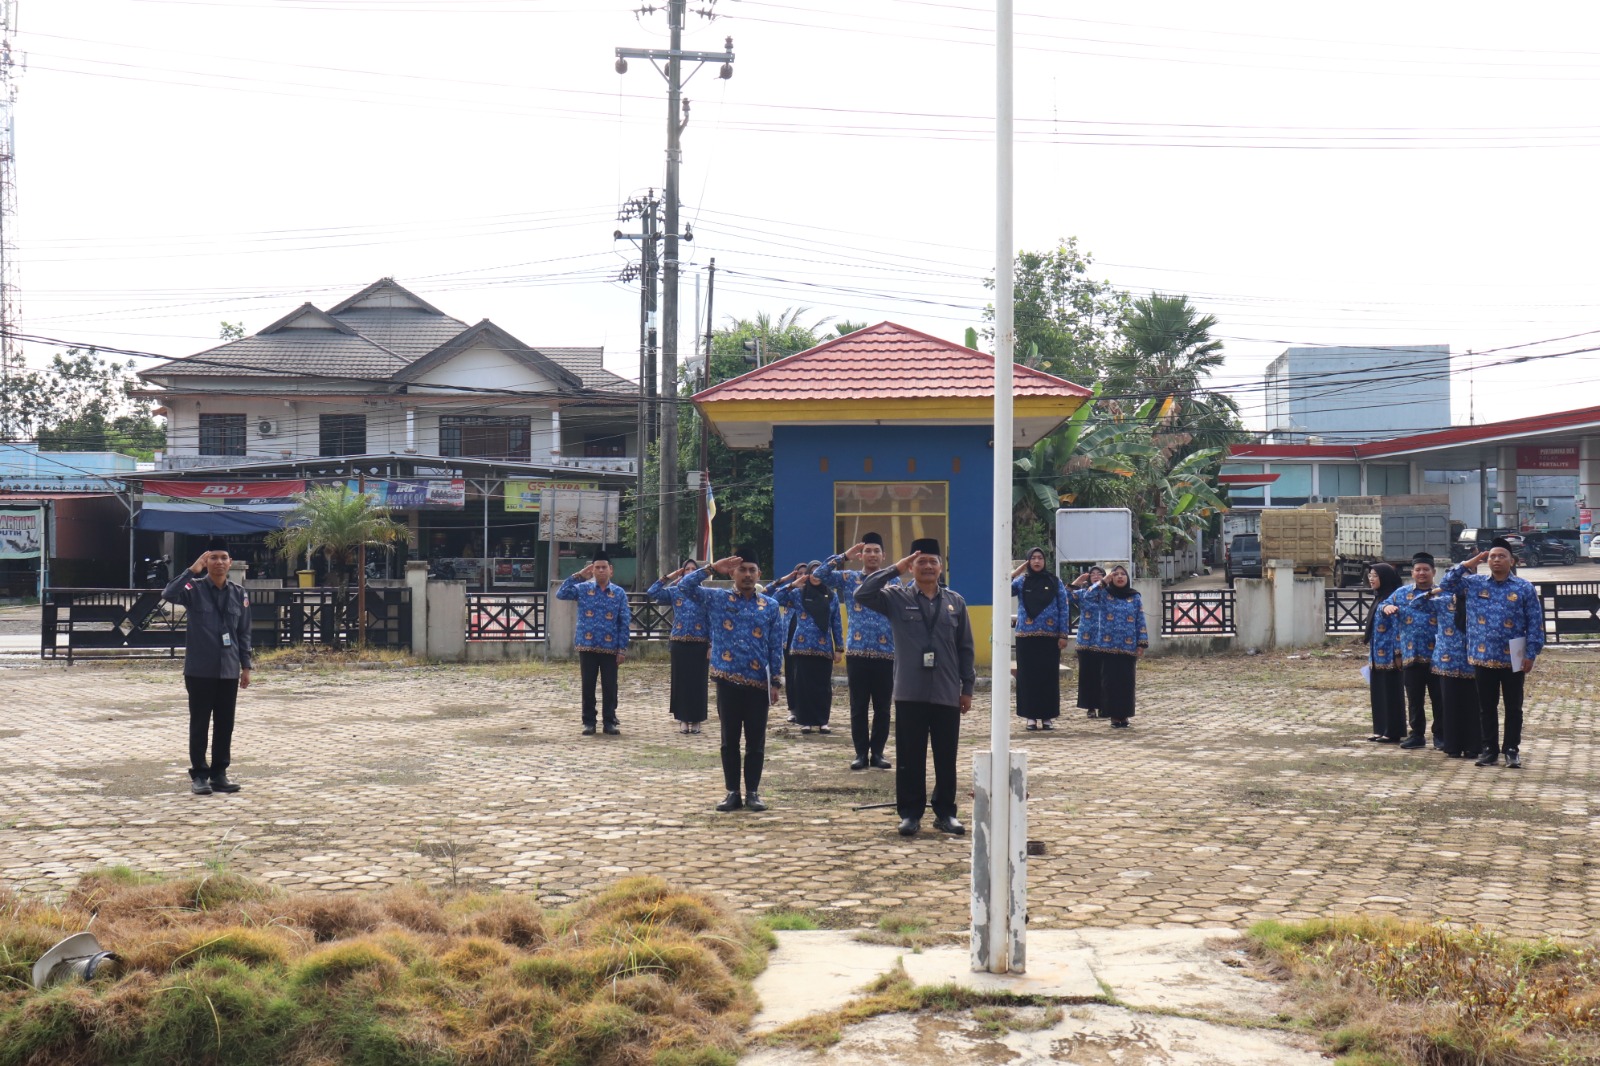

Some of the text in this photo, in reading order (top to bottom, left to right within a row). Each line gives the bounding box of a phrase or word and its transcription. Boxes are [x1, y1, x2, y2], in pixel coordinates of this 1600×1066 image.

[200, 485, 244, 495] FDR
[396, 484, 418, 493] IRC
[528, 481, 546, 491] GS
[0, 515, 36, 530] ARTINI
